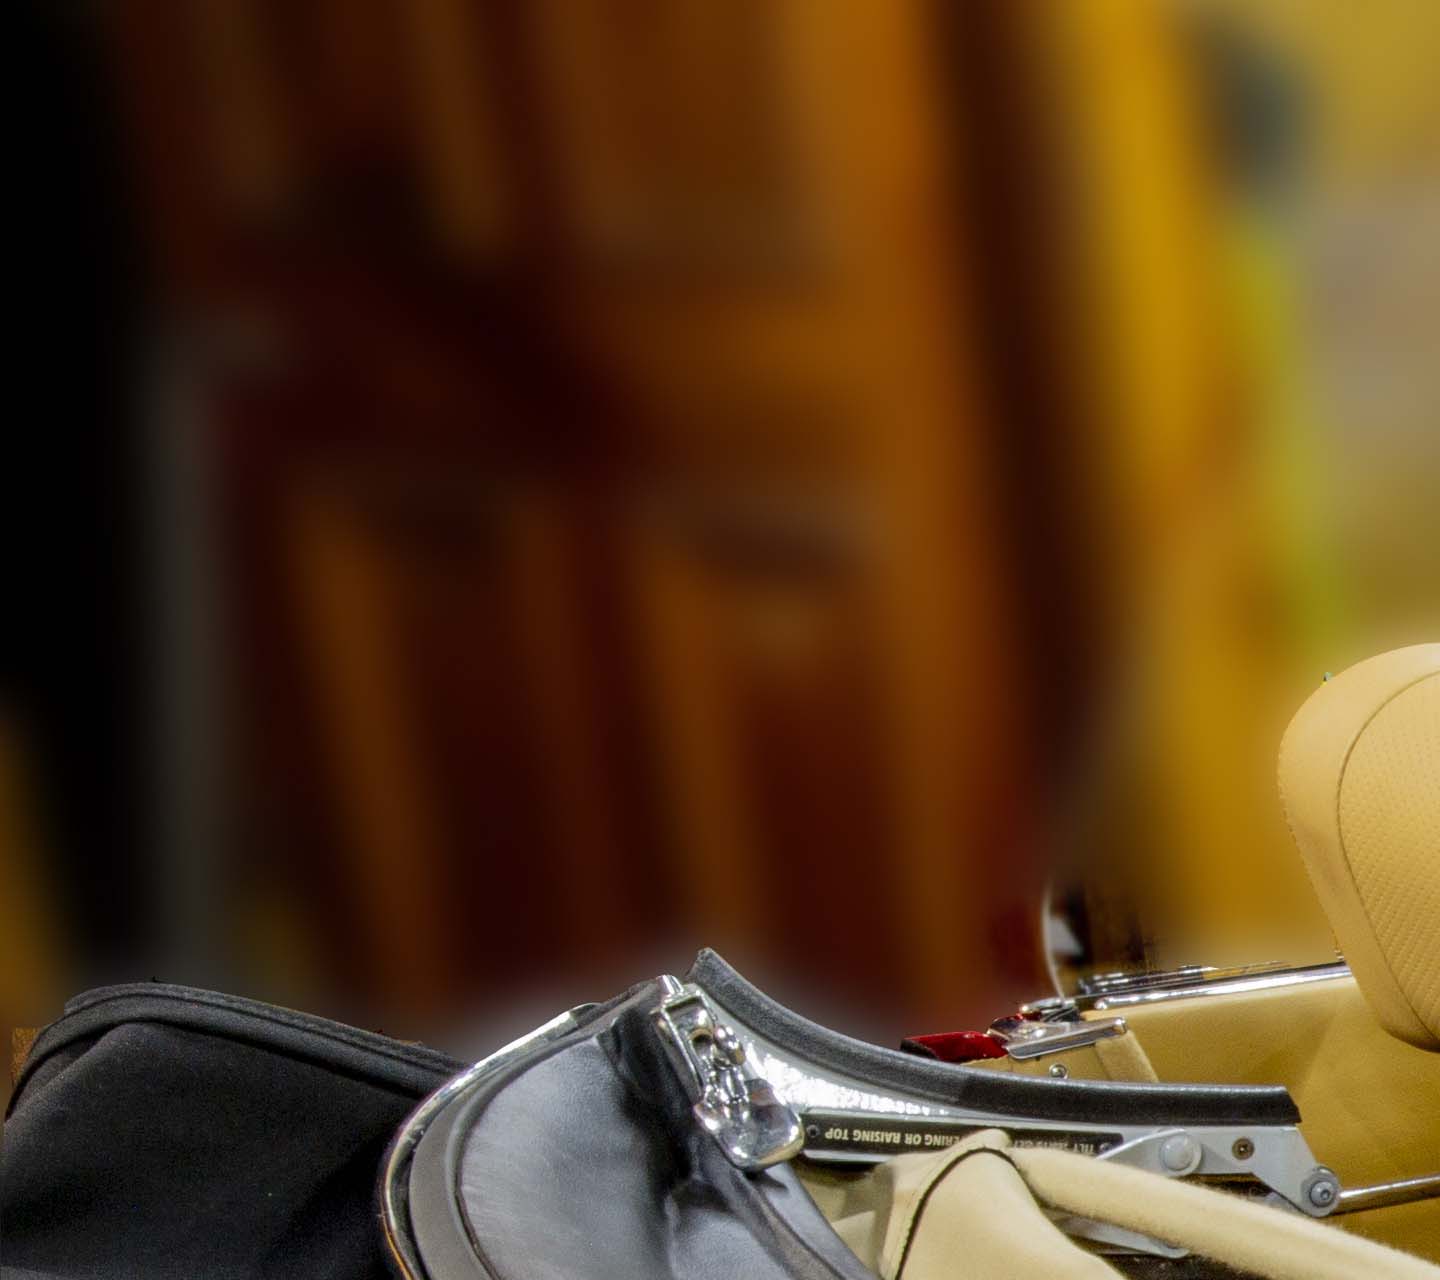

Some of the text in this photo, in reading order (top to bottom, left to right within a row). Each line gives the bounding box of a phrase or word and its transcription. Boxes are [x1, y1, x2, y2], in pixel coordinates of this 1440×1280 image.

[824, 1126, 961, 1147] ERING OR RAISING TOP
